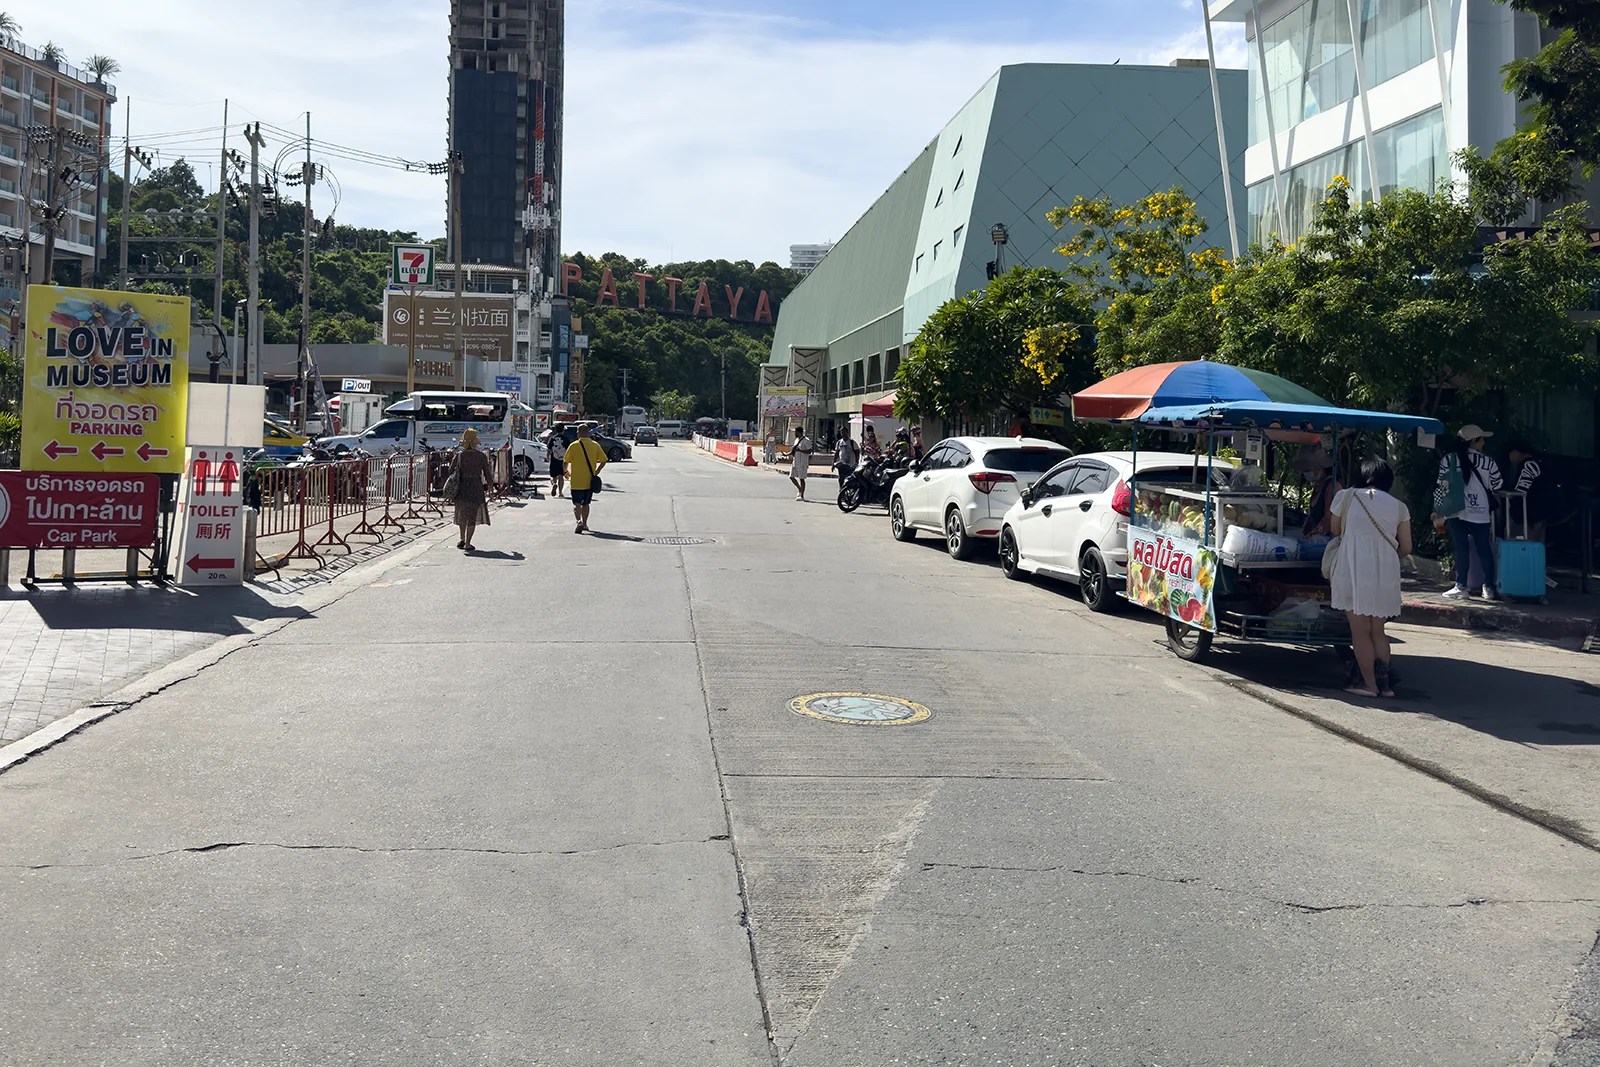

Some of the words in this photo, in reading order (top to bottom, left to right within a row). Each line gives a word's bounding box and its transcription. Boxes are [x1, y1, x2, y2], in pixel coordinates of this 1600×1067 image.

[403, 252, 424, 283] 7
[561, 262, 773, 323] PATTAYA
[432, 307, 509, 327] 兰州拉面
[46, 326, 145, 358] LOVE
[150, 338, 173, 357] IN
[46, 363, 172, 388] MUSEUM
[357, 382, 370, 390] OUT
[56, 390, 157, 422] ที่จอดรถ
[70, 421, 143, 436] PARKING
[25, 474, 145, 493] บริการจอดรถ
[25, 495, 144, 521] ไปเกาะล้าน
[189, 505, 239, 517] TOILET
[47, 528, 77, 543] Car
[81, 529, 118, 543] Park
[1133, 537, 1194, 580] ผลไม้สด
[208, 572, 218, 580] 20
